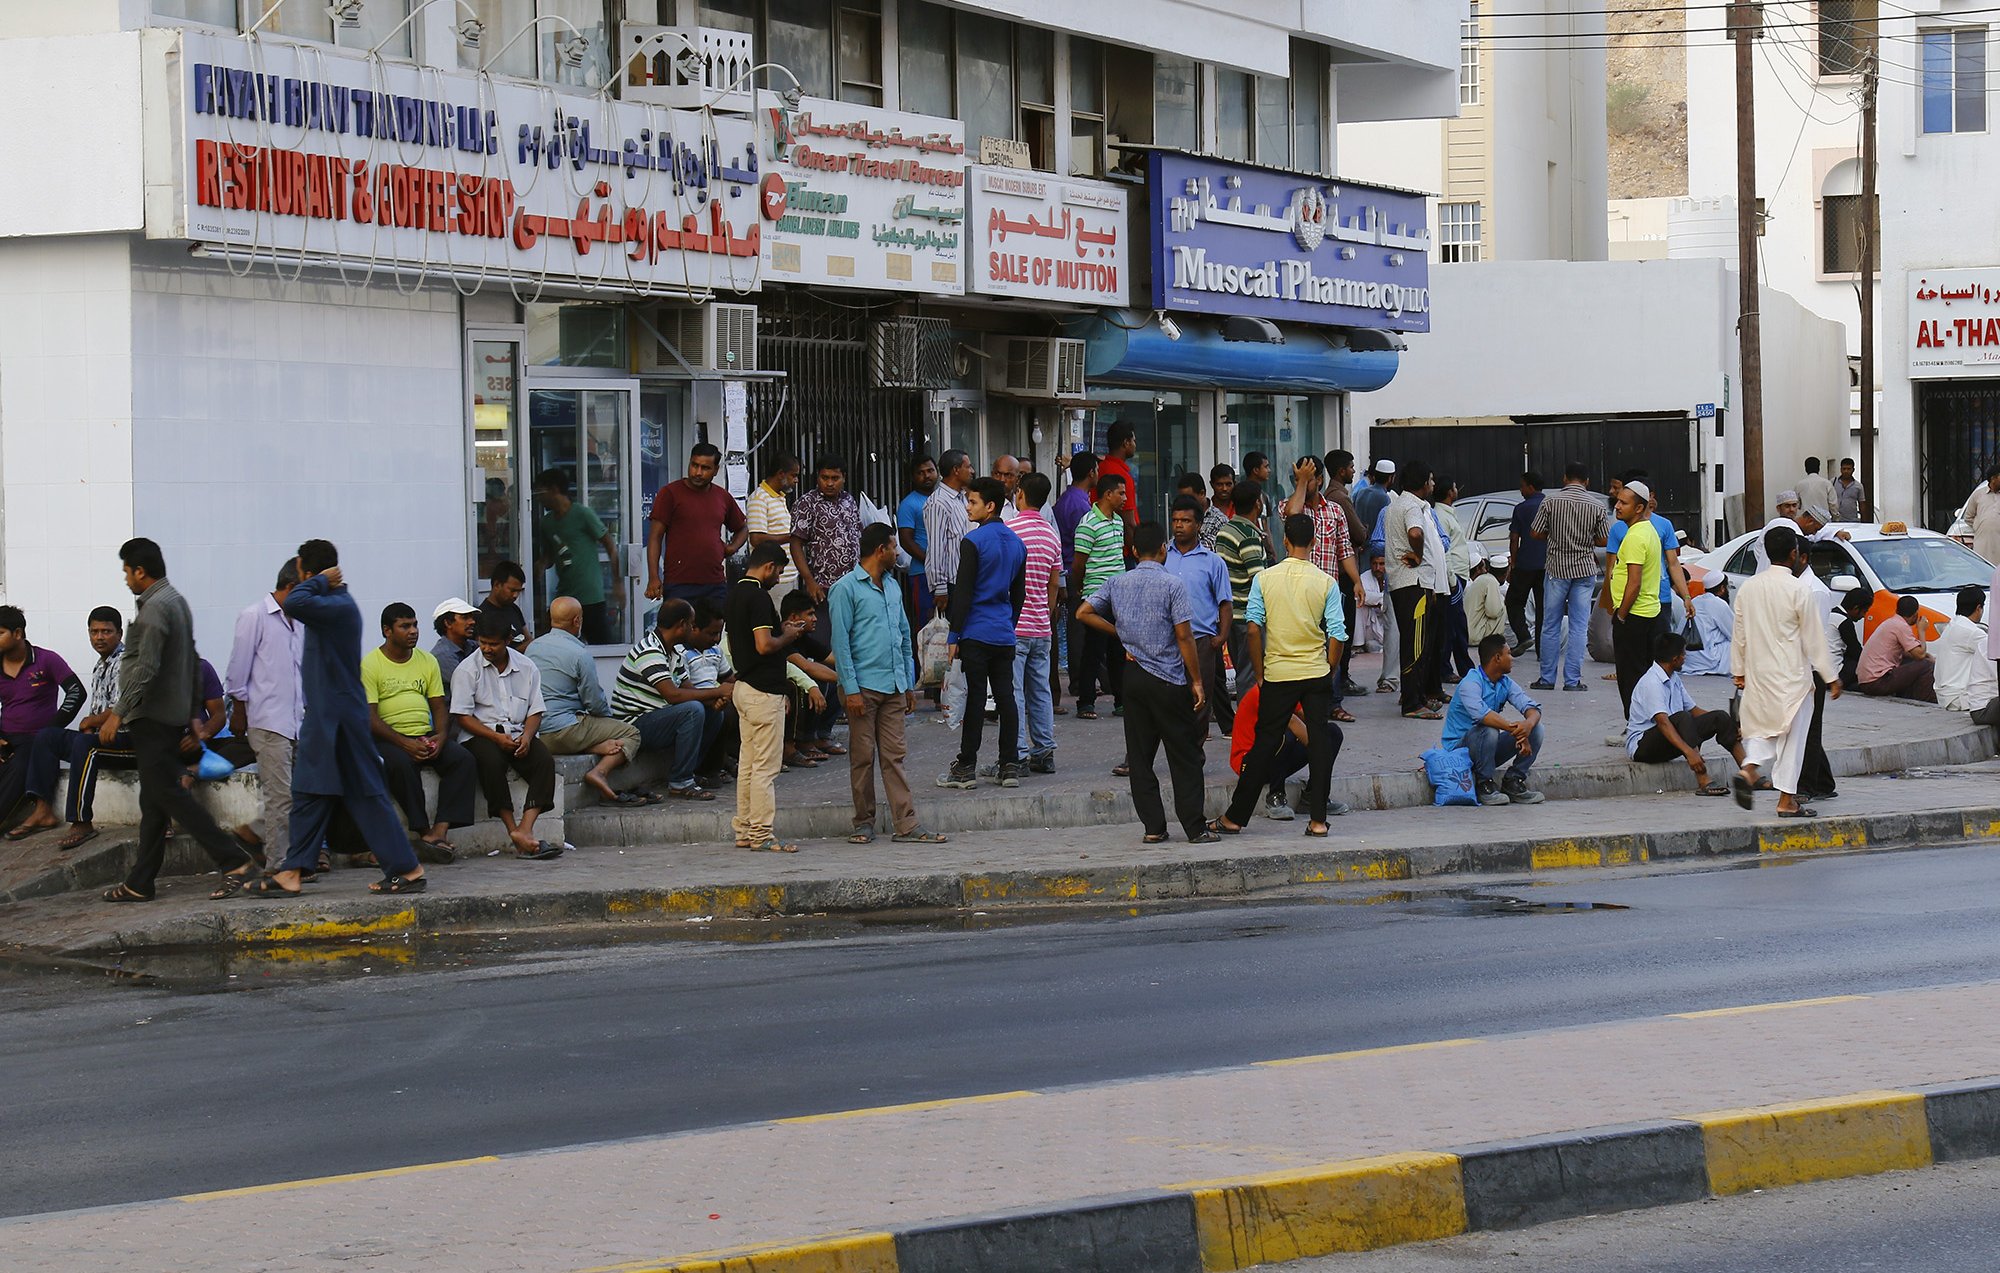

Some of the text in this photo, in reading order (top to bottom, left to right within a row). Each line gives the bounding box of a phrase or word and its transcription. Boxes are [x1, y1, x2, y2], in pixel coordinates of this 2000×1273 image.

[351, 88, 456, 149] TRADING
[457, 105, 498, 155] LLC
[196, 138, 514, 238] RESTAURANT & COFFEE SHOP
[792, 144, 849, 173] Oman
[848, 152, 903, 181] Travel
[901, 160, 965, 188] Bureau
[988, 175, 1004, 192] MUSCAT
[1004, 179, 1022, 194] MODERN
[784, 181, 848, 214] Biman
[988, 205, 1117, 259] بيع اللحوم
[989, 251, 1118, 293] SALE OF MUTTON
[1172, 245, 1430, 319] Muscat Pharmacy LLC
